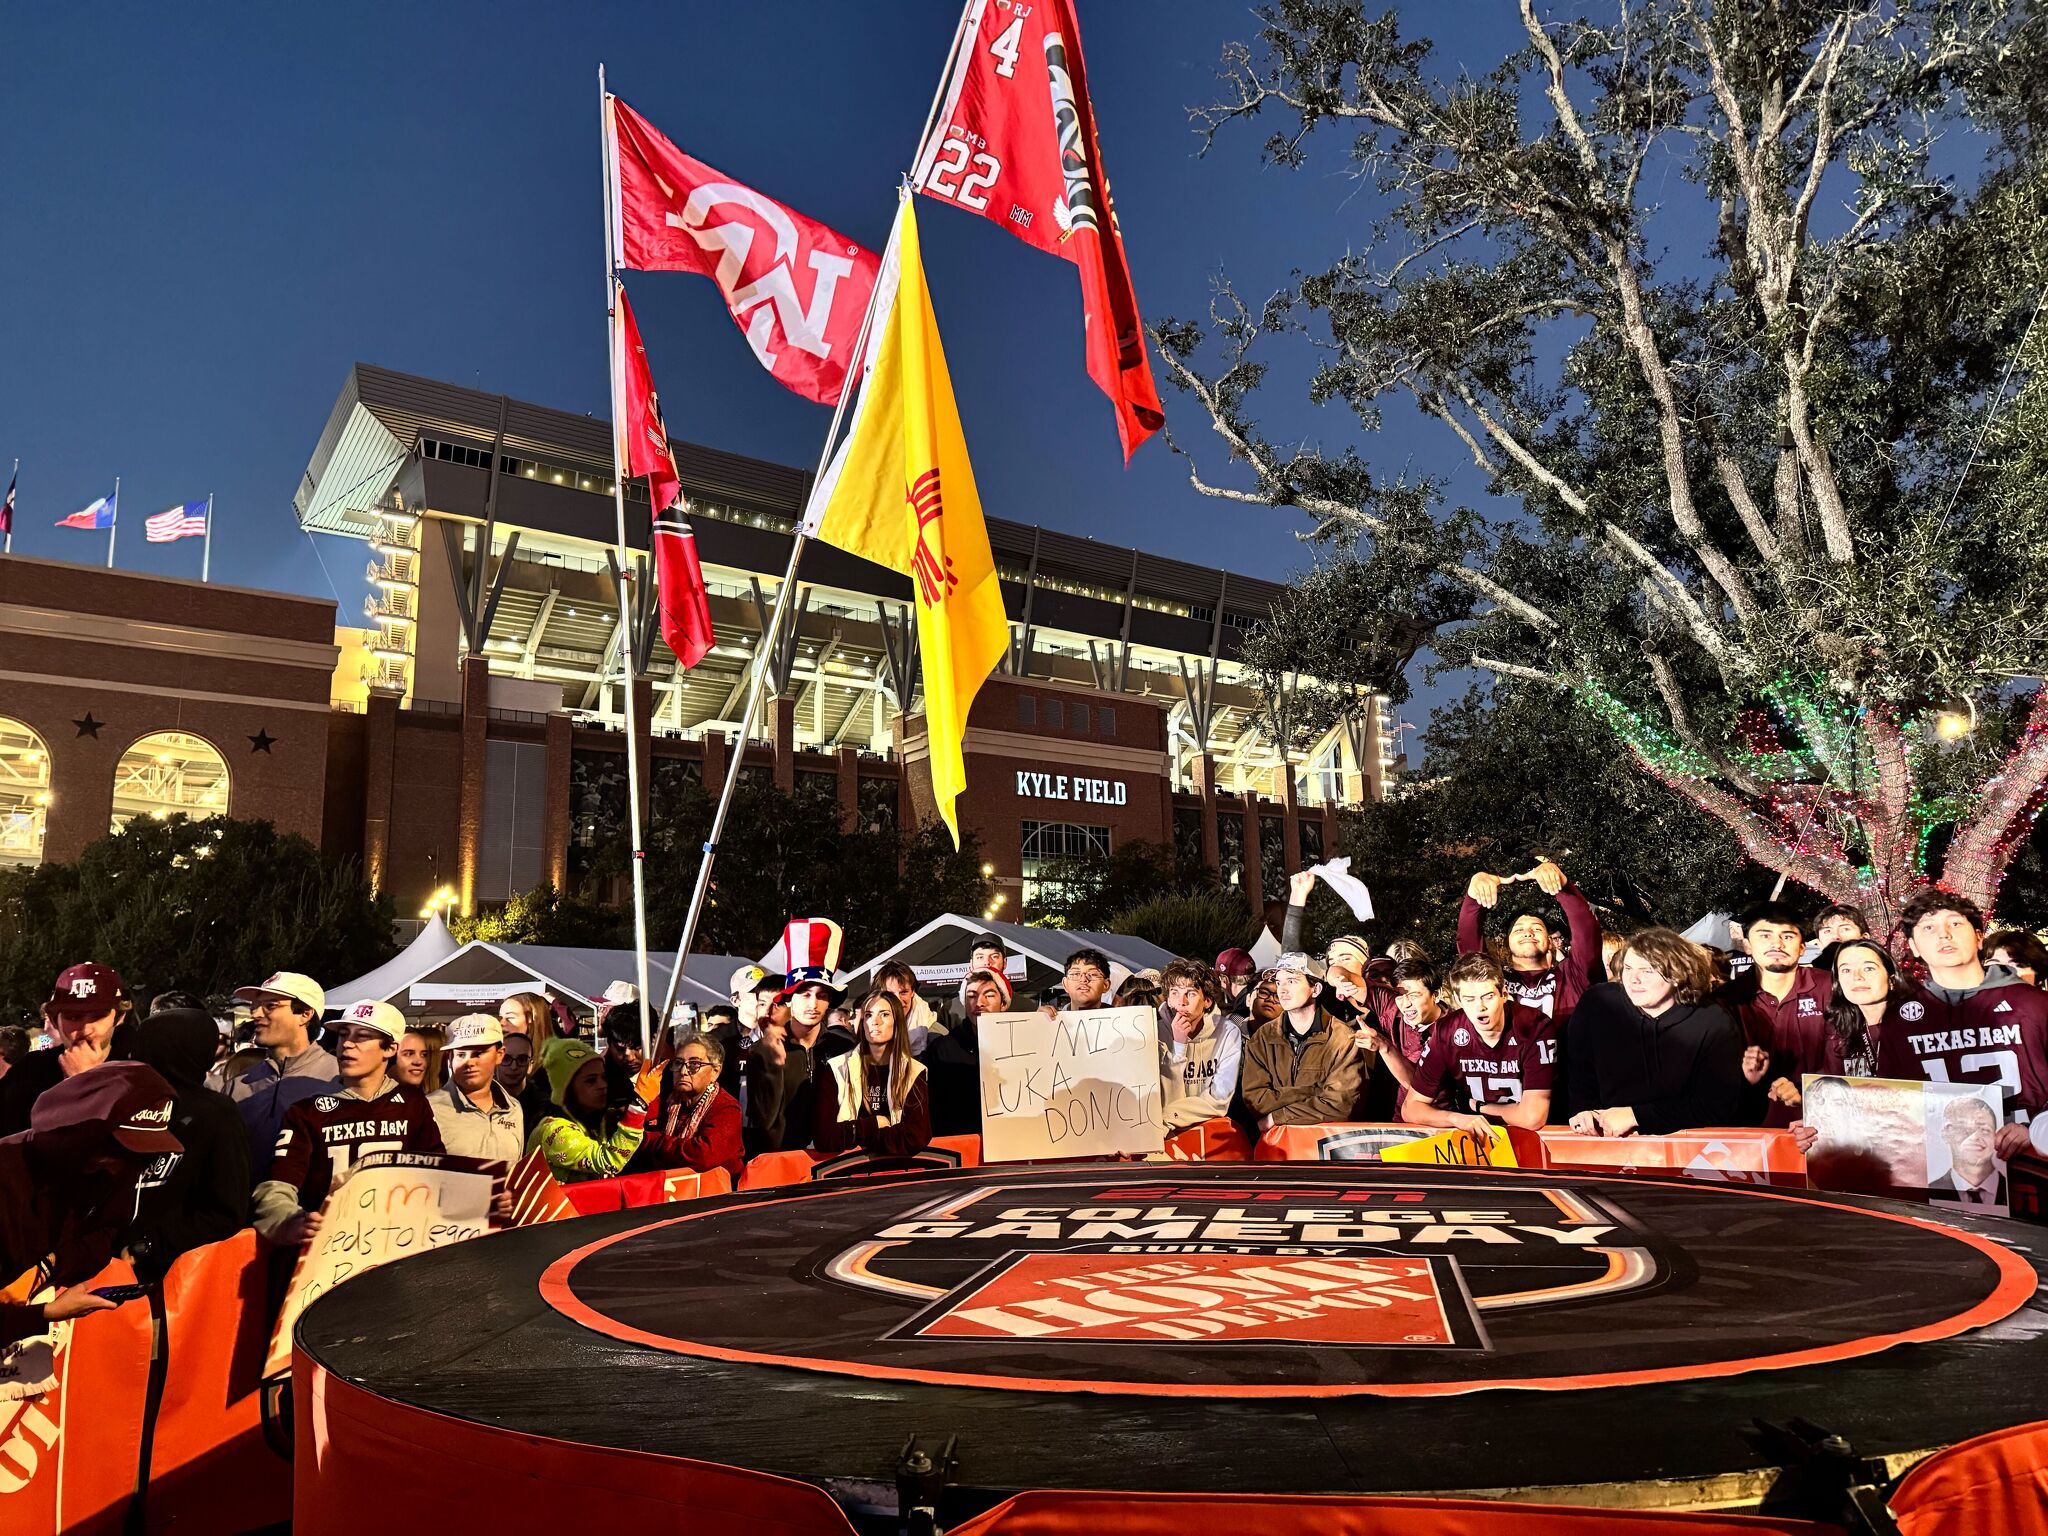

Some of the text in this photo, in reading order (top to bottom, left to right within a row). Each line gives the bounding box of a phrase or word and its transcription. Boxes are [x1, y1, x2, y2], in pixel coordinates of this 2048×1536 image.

[1013, 3, 1033, 17] RJ
[988, 16, 1025, 80] 4
[966, 130, 987, 149] MB
[926, 137, 1001, 210] 22
[1016, 771, 1127, 806] KYLE FIELD
[1901, 1001, 1924, 1021] SEC
[995, 1015, 1147, 1060] I MISS
[1907, 1024, 2023, 1055] TEXAS A&M
[1536, 1039, 1558, 1065] 12
[1460, 1059, 1521, 1074] TEXAS A&M
[982, 1062, 1073, 1117] LUKA
[315, 1096, 338, 1111] SEC
[322, 1119, 408, 1143] TEXAS A&M
[396, 1153, 442, 1167] DEPOT
[1091, 1187, 1427, 1202] ESPN
[996, 1206, 1516, 1224] COLLEGE
[874, 1221, 1618, 1244] GAMEDAY
[1109, 1245, 1350, 1256] BUILT BY
[1033, 1261, 1219, 1290] THE
[948, 1258, 1429, 1337] HOME
[1126, 1284, 1435, 1339] DEPOT
